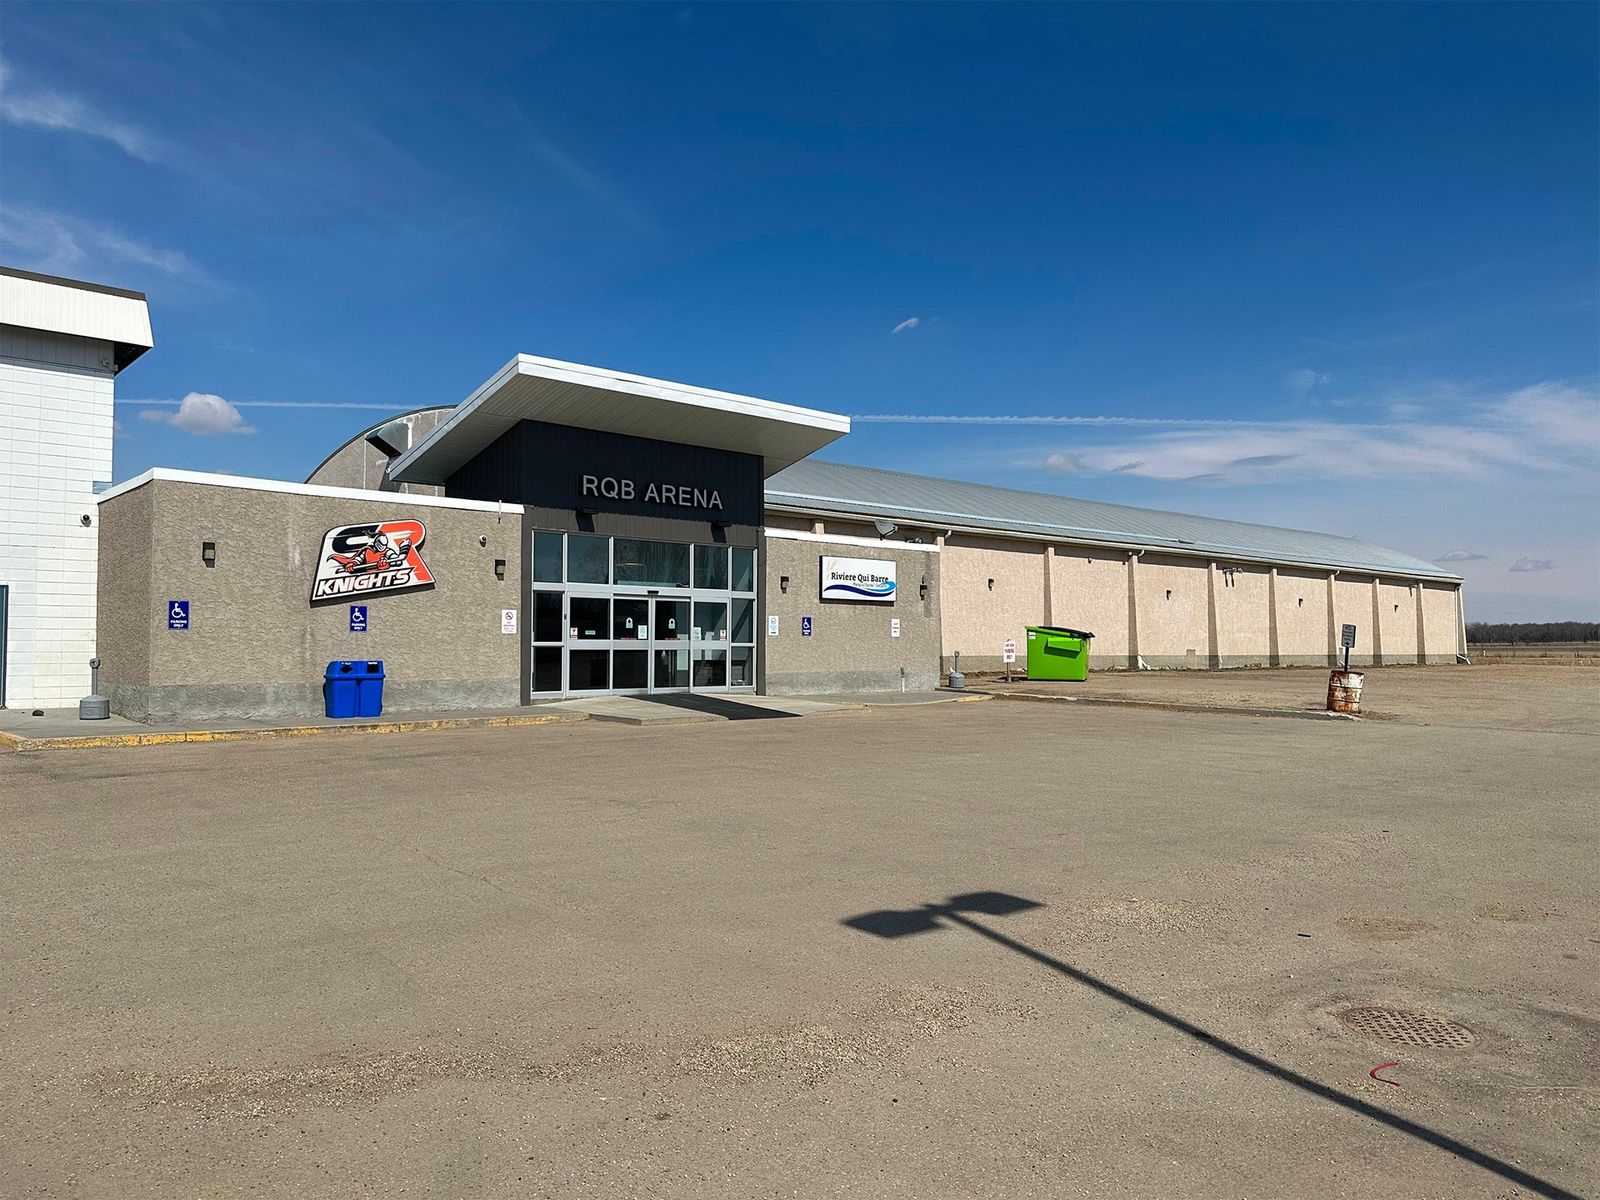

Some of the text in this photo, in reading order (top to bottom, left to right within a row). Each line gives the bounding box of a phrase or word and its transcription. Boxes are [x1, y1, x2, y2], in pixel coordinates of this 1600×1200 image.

[582, 474, 724, 510] RQB ARENA
[315, 568, 412, 597] KNIGHTS
[831, 571, 889, 583] Riviere Qui Barre
